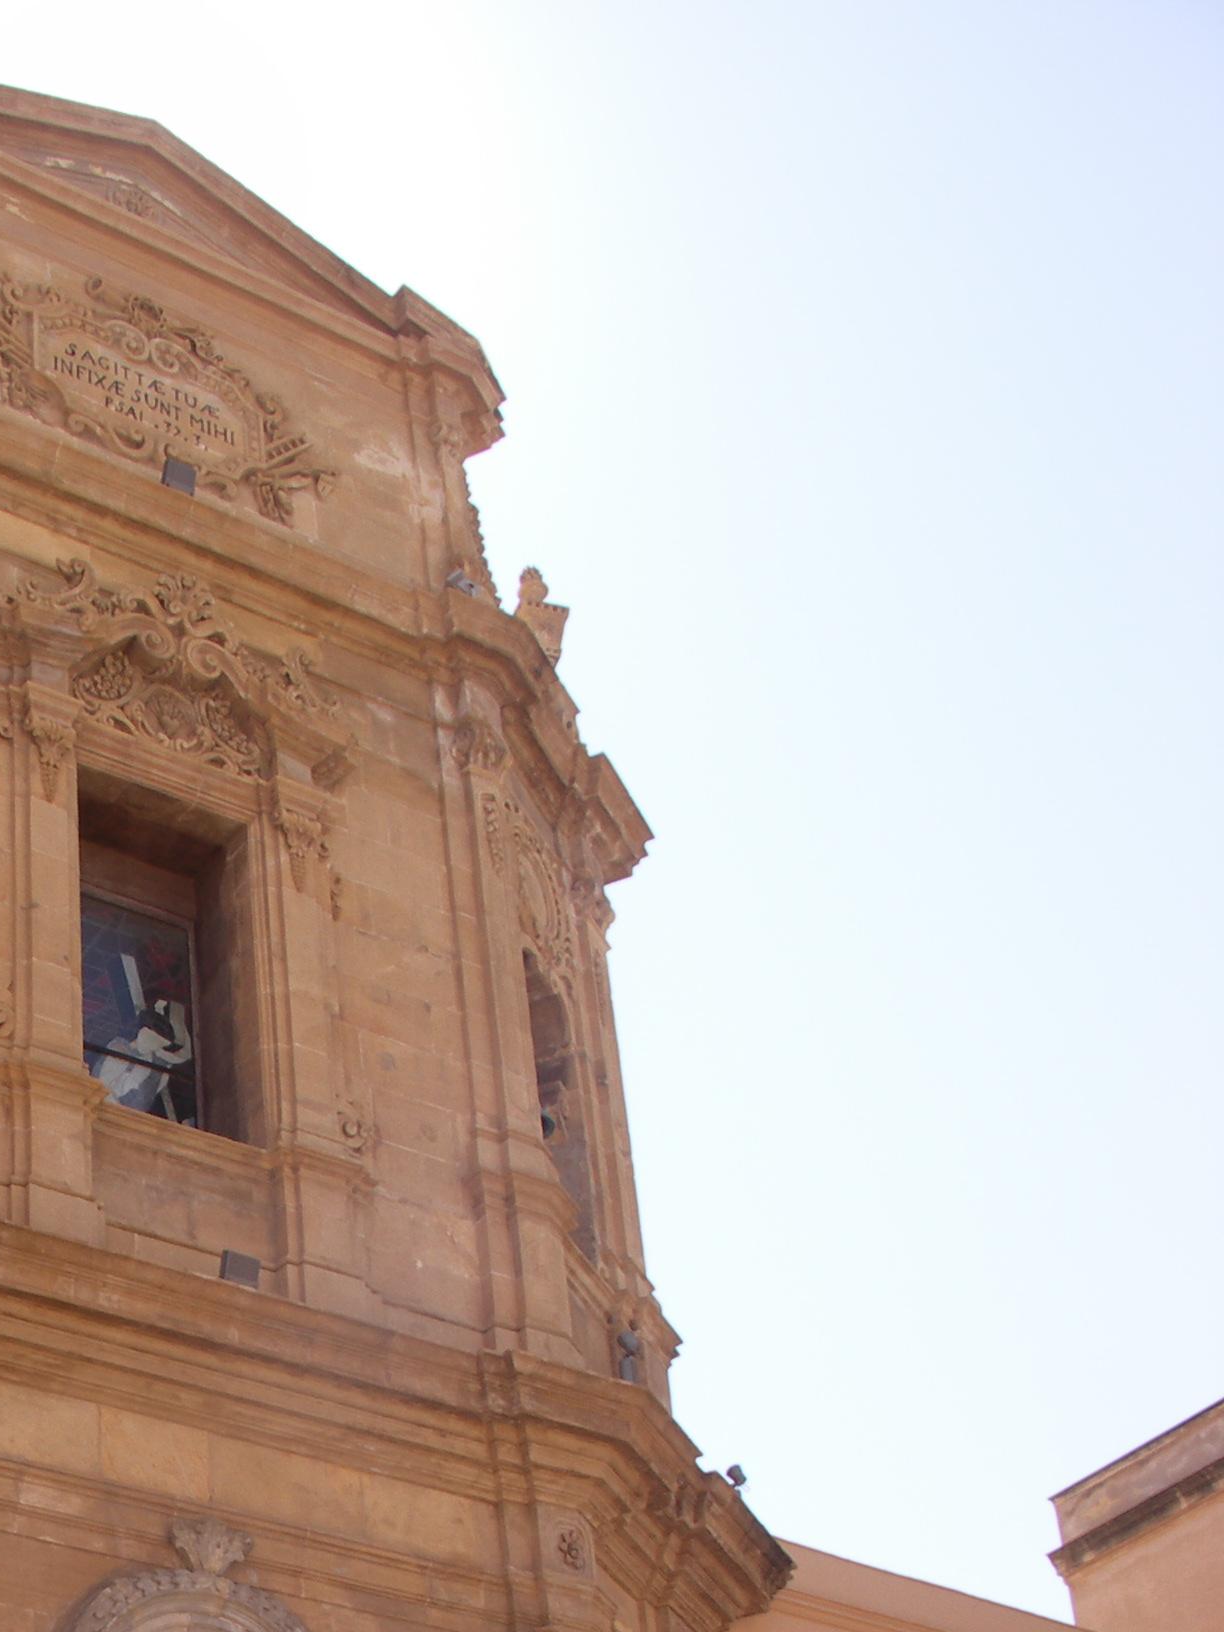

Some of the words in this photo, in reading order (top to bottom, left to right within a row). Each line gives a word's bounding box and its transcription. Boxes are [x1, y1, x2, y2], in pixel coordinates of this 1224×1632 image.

[53, 355, 126, 398] INFIXÆ
[130, 388, 182, 421] SUNT
[189, 413, 236, 446] MIHI
[171, 387, 221, 418] TUÆ
